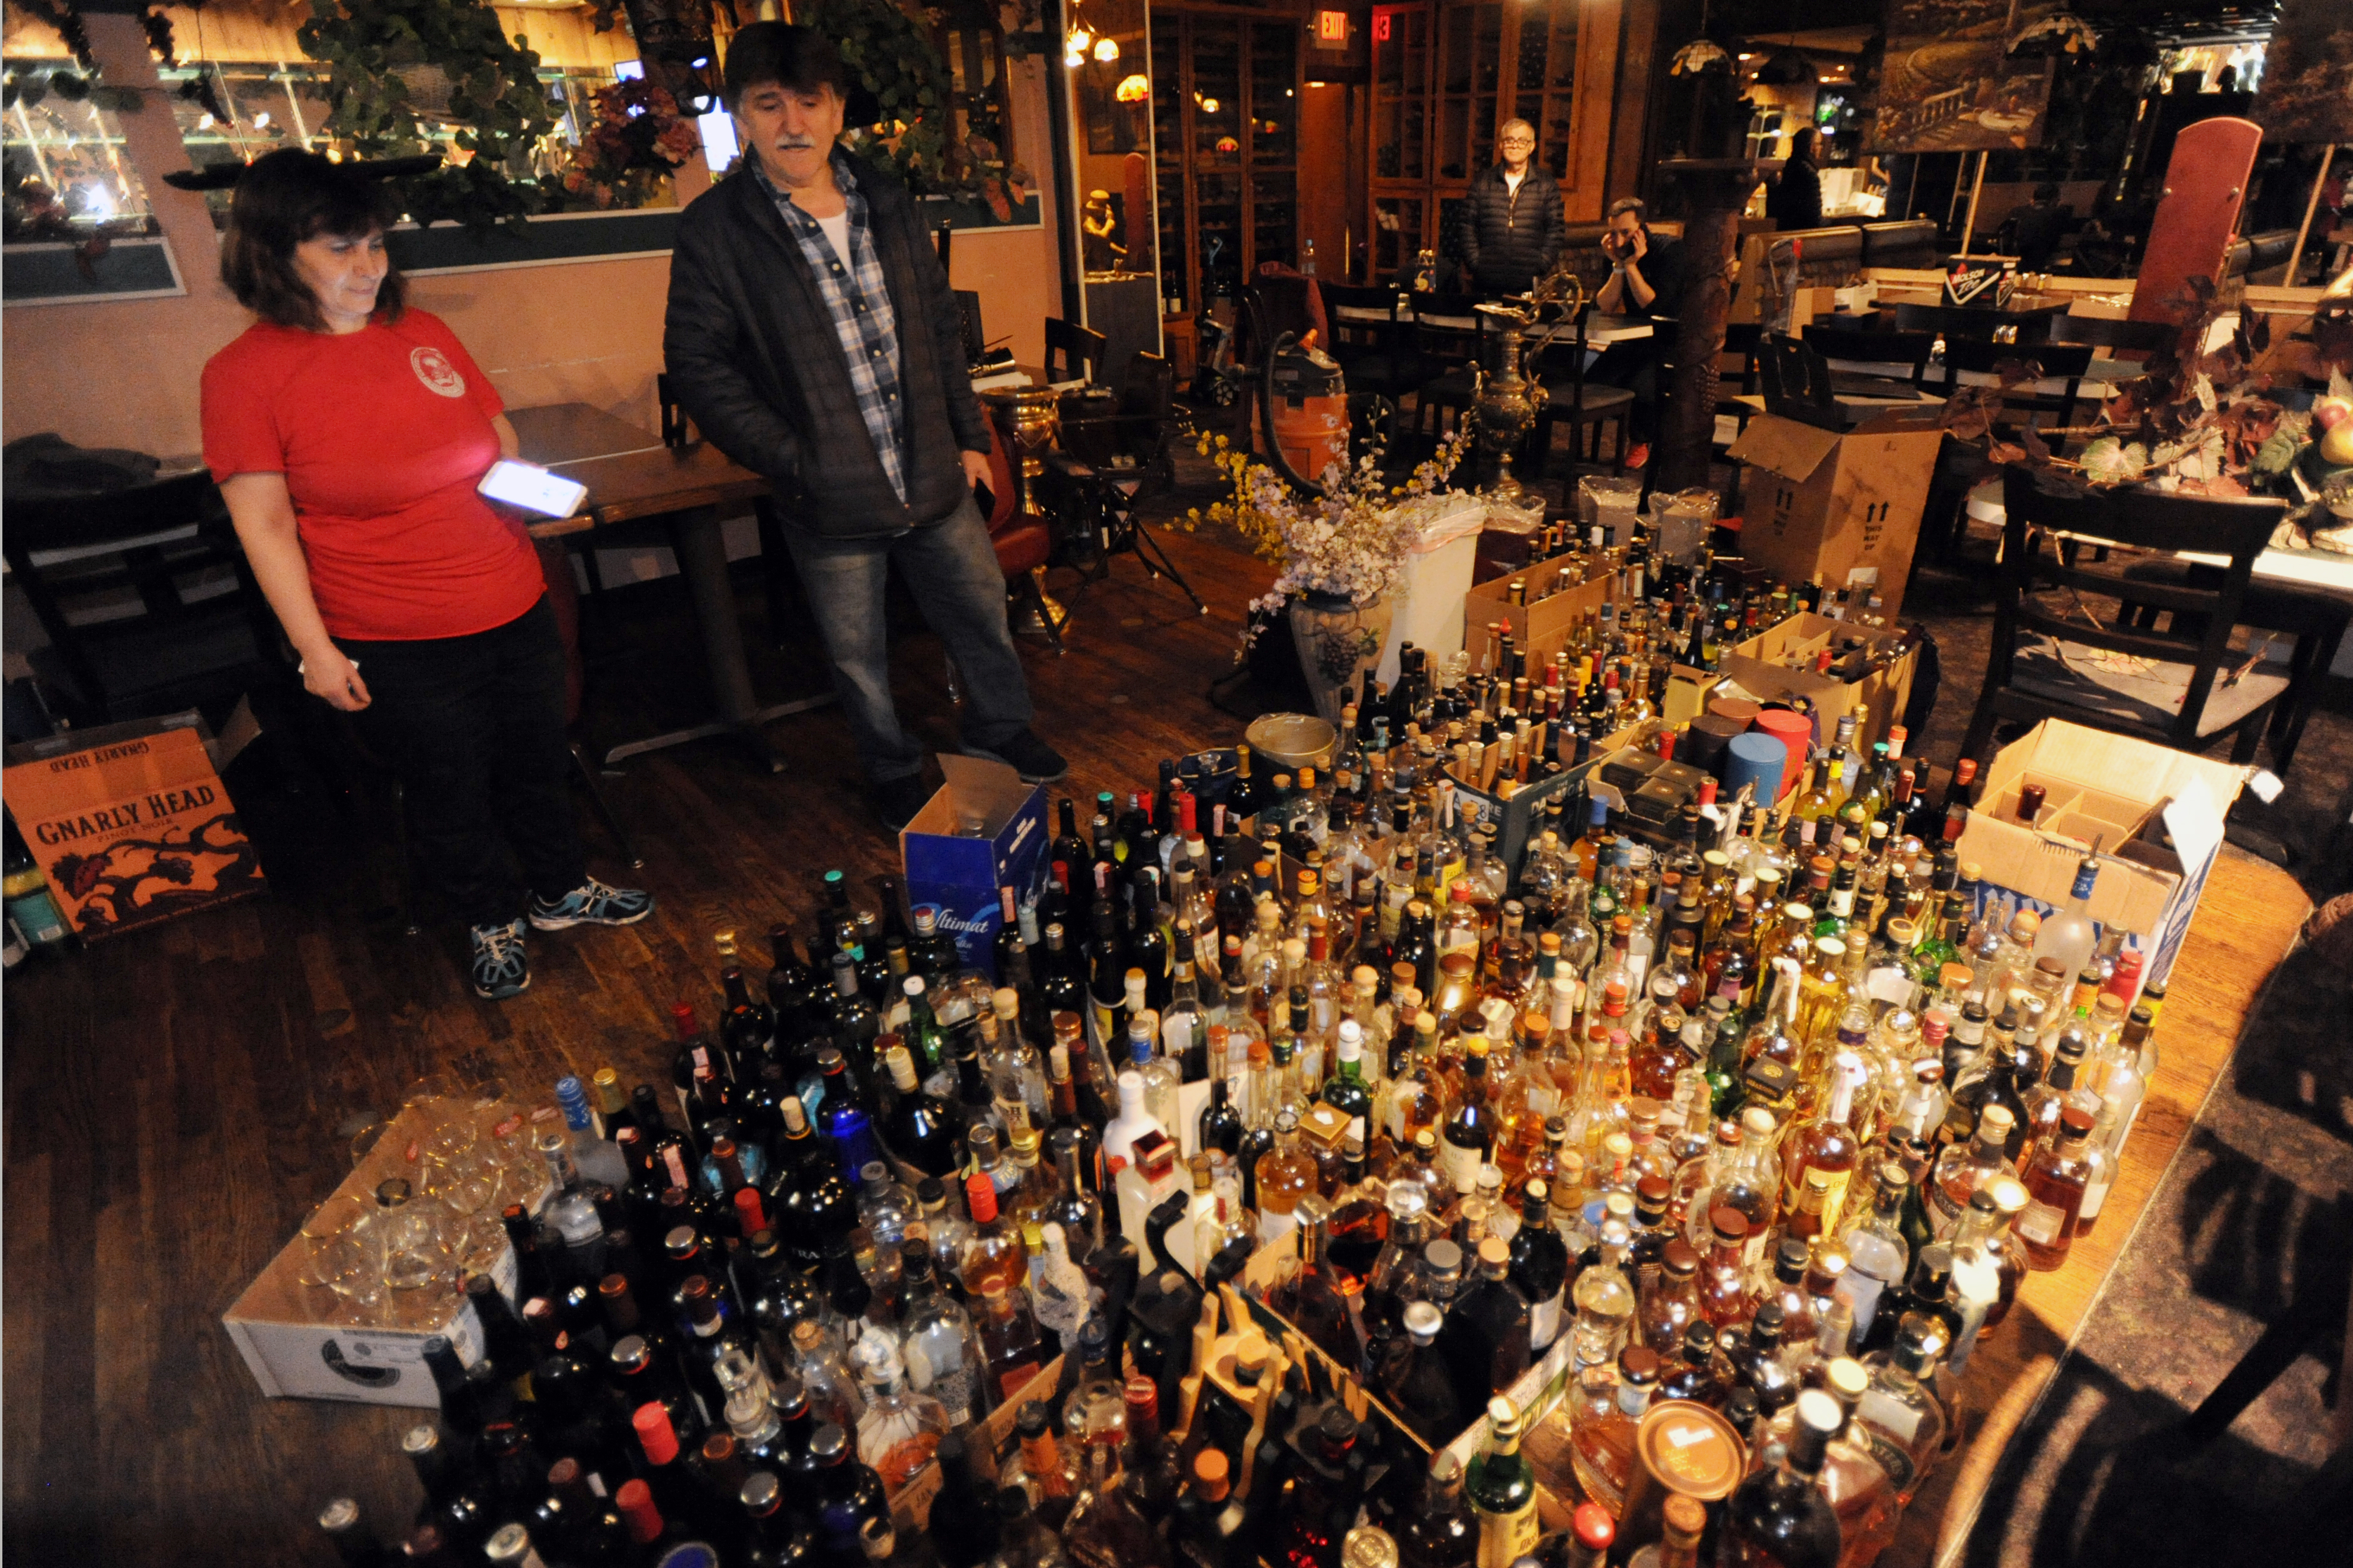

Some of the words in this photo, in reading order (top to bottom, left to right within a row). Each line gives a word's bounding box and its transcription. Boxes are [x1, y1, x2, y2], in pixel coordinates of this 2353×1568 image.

[1321, 11, 1346, 40] EXIT
[1951, 268, 1985, 284] MOLSON
[1957, 279, 1981, 296] Ice
[50, 755, 89, 773] HEAD
[95, 742, 149, 765] GNARLY
[37, 803, 142, 846] GNARLY
[145, 785, 216, 818] HEAD
[98, 828, 138, 842] PINOT
[141, 817, 173, 831] NOIR
